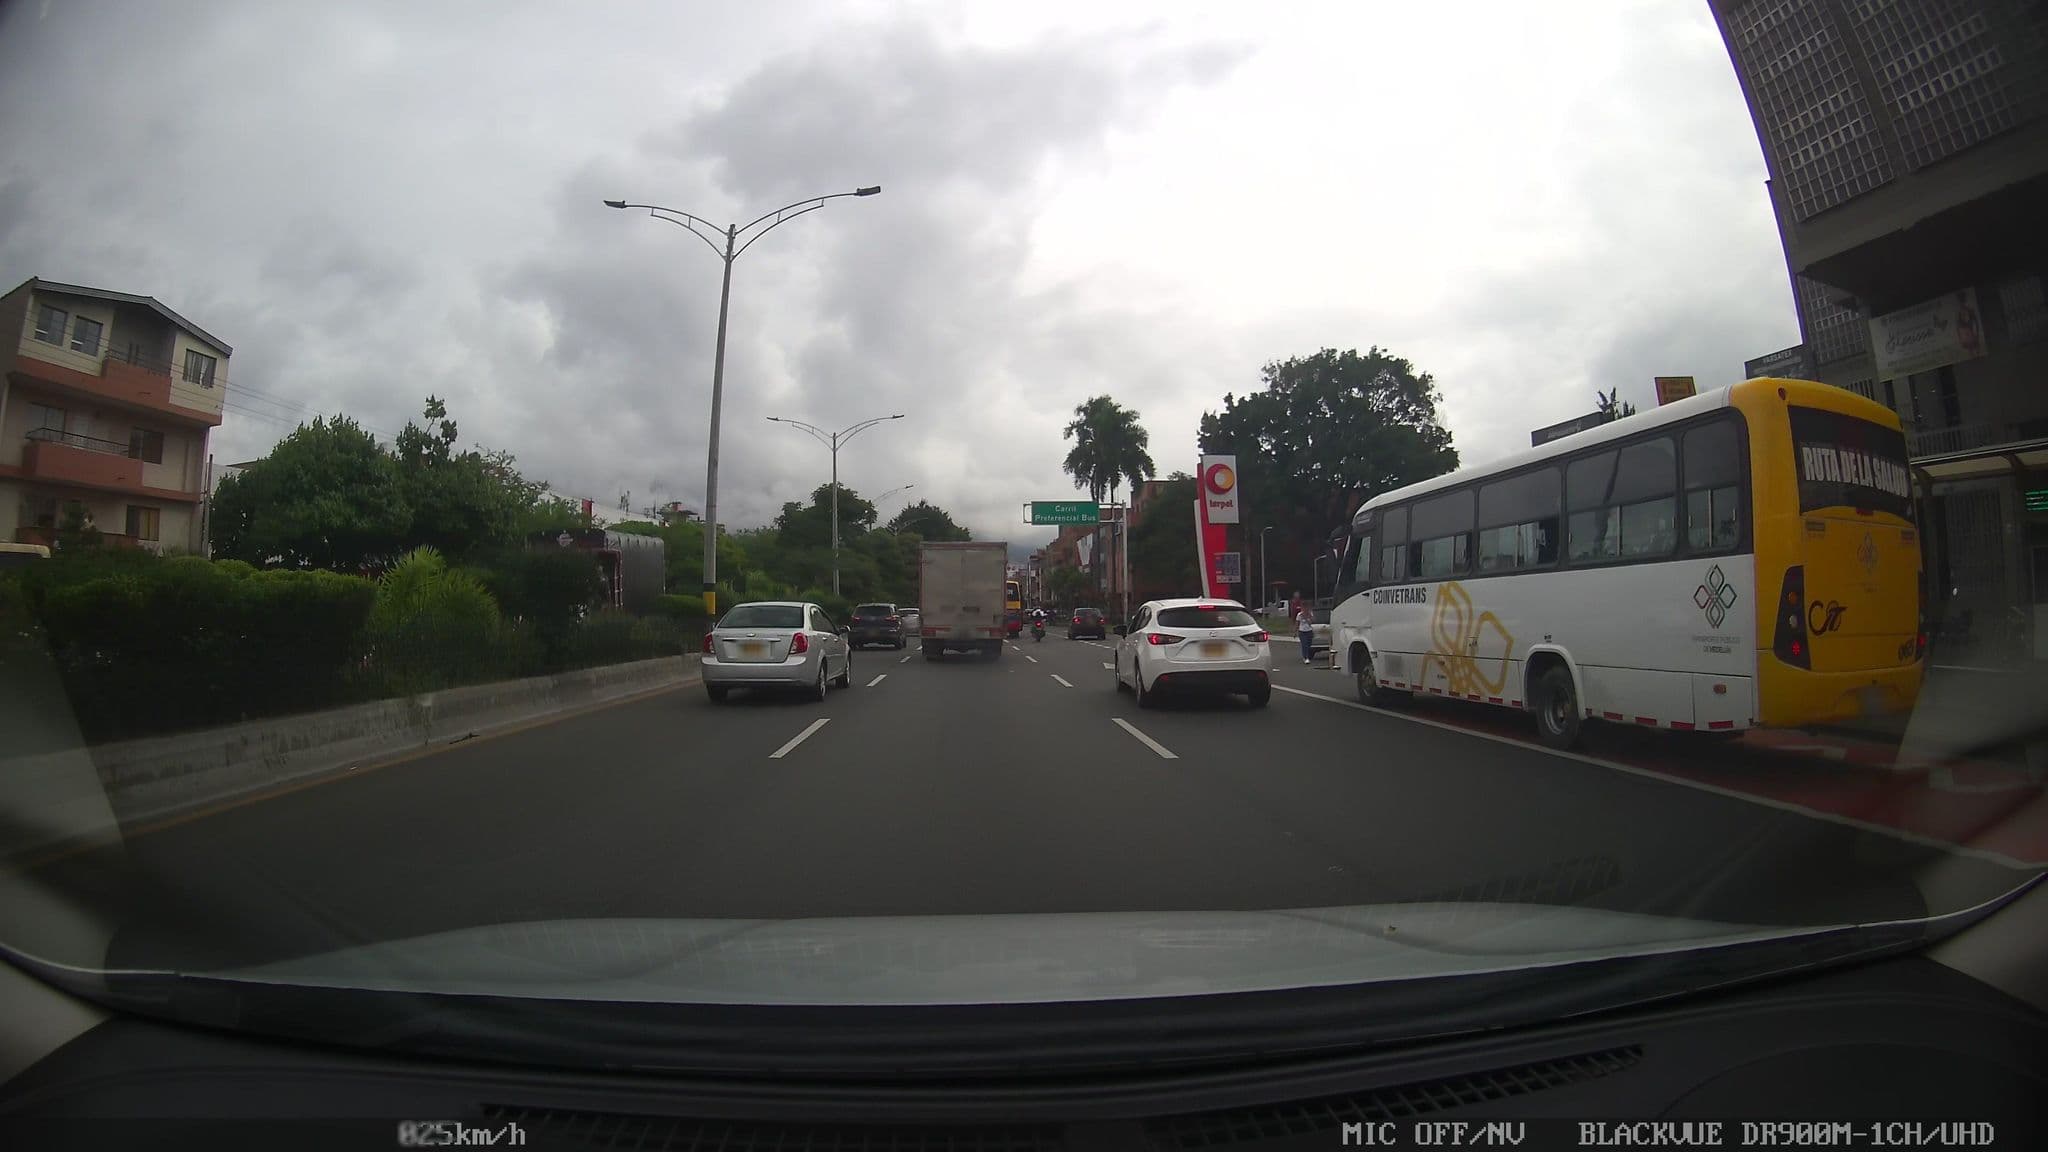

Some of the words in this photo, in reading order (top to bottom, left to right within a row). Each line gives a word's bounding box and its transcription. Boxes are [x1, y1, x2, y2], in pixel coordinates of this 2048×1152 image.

[1802, 447, 1841, 481] RUTA
[1840, 450, 1859, 485] DE
[1857, 453, 1875, 488] LA
[1872, 457, 1909, 498] SALUD
[1209, 499, 1234, 510] terpel
[1373, 587, 1427, 605] COINVETRANS
